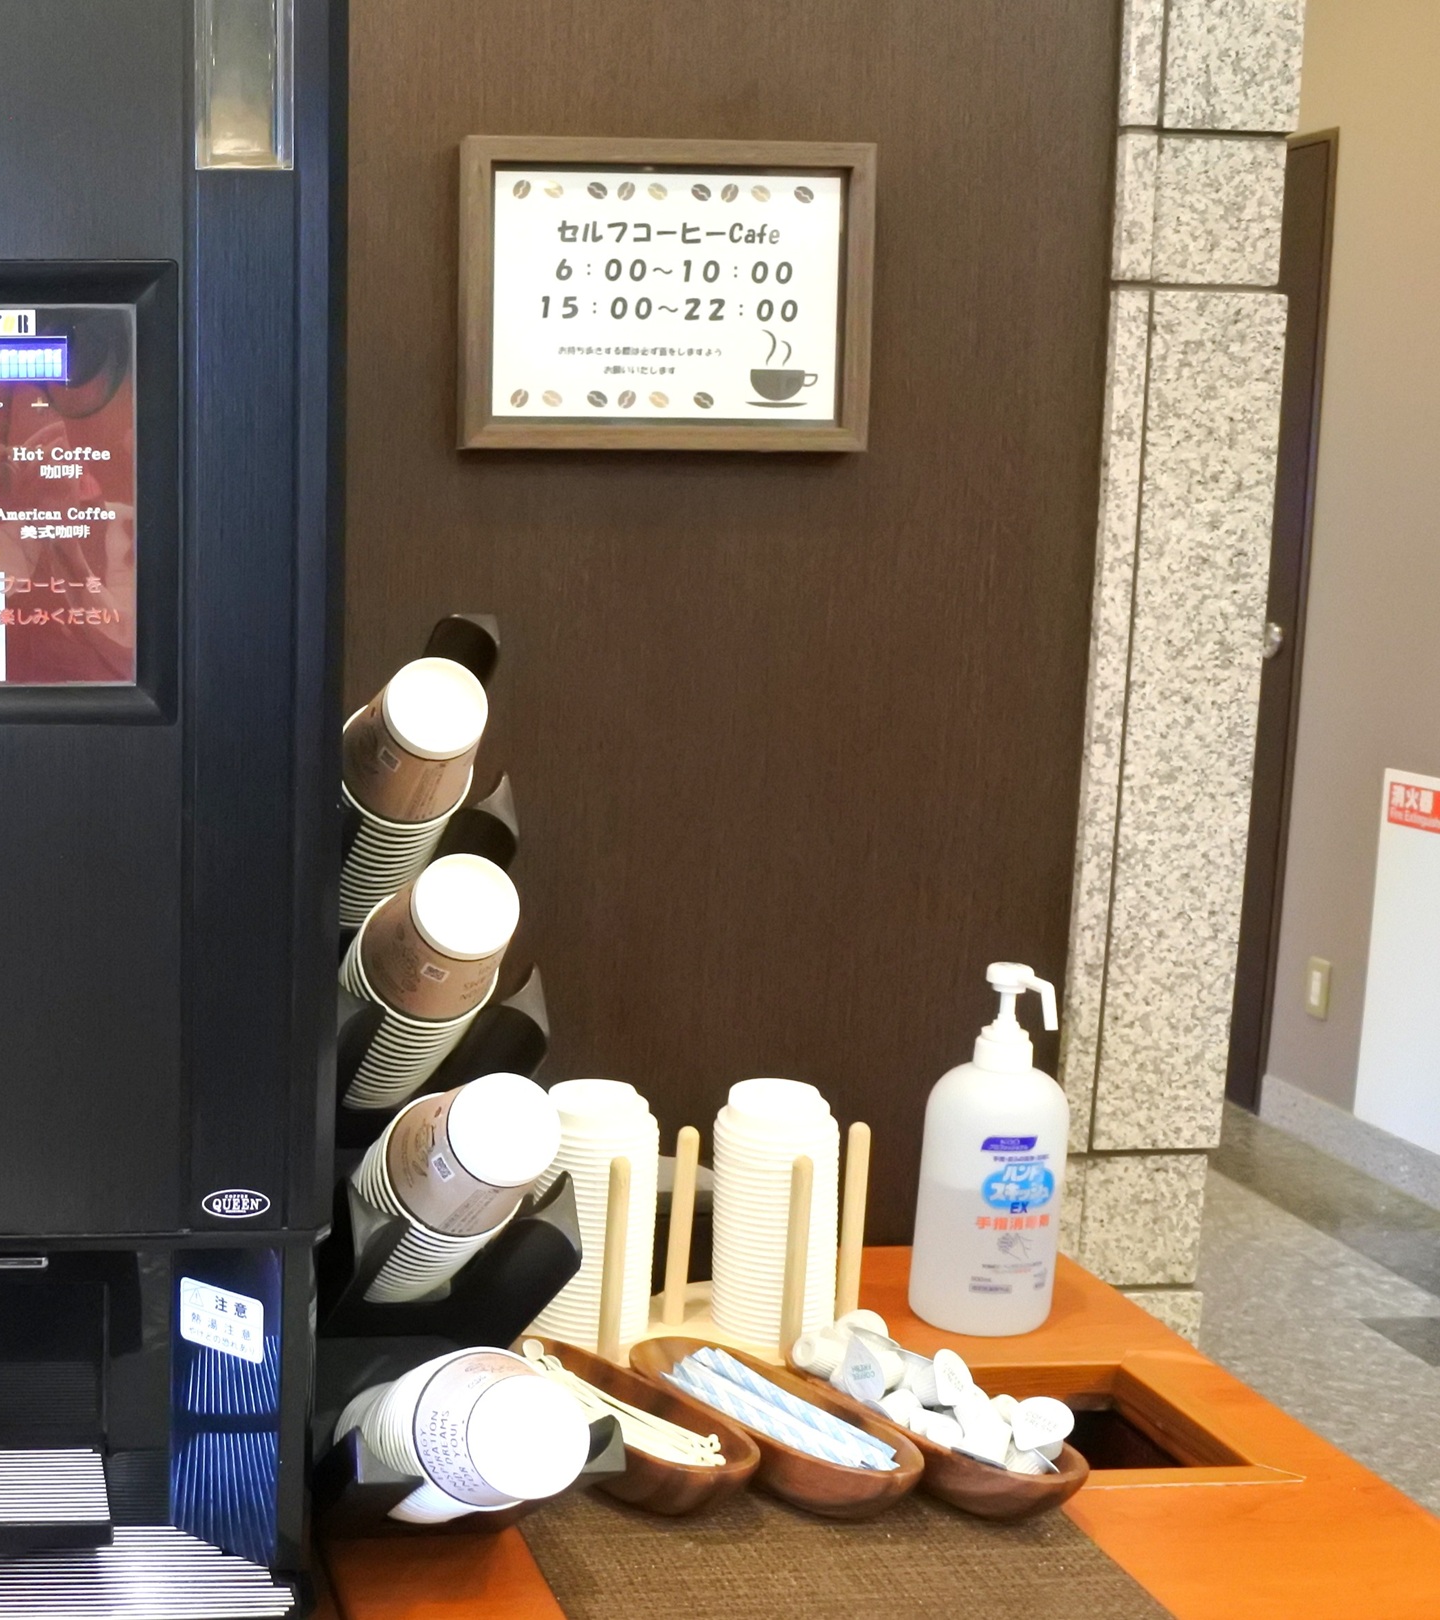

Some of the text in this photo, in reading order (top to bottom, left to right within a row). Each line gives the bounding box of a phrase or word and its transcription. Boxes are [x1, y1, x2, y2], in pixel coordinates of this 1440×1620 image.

[12, 447, 112, 462] Hot Coffee
[66, 507, 117, 522] Coffee
[212, 1198, 263, 1213] QUEEN
[1009, 1201, 1030, 1214] EX
[214, 1295, 248, 1319] 注意
